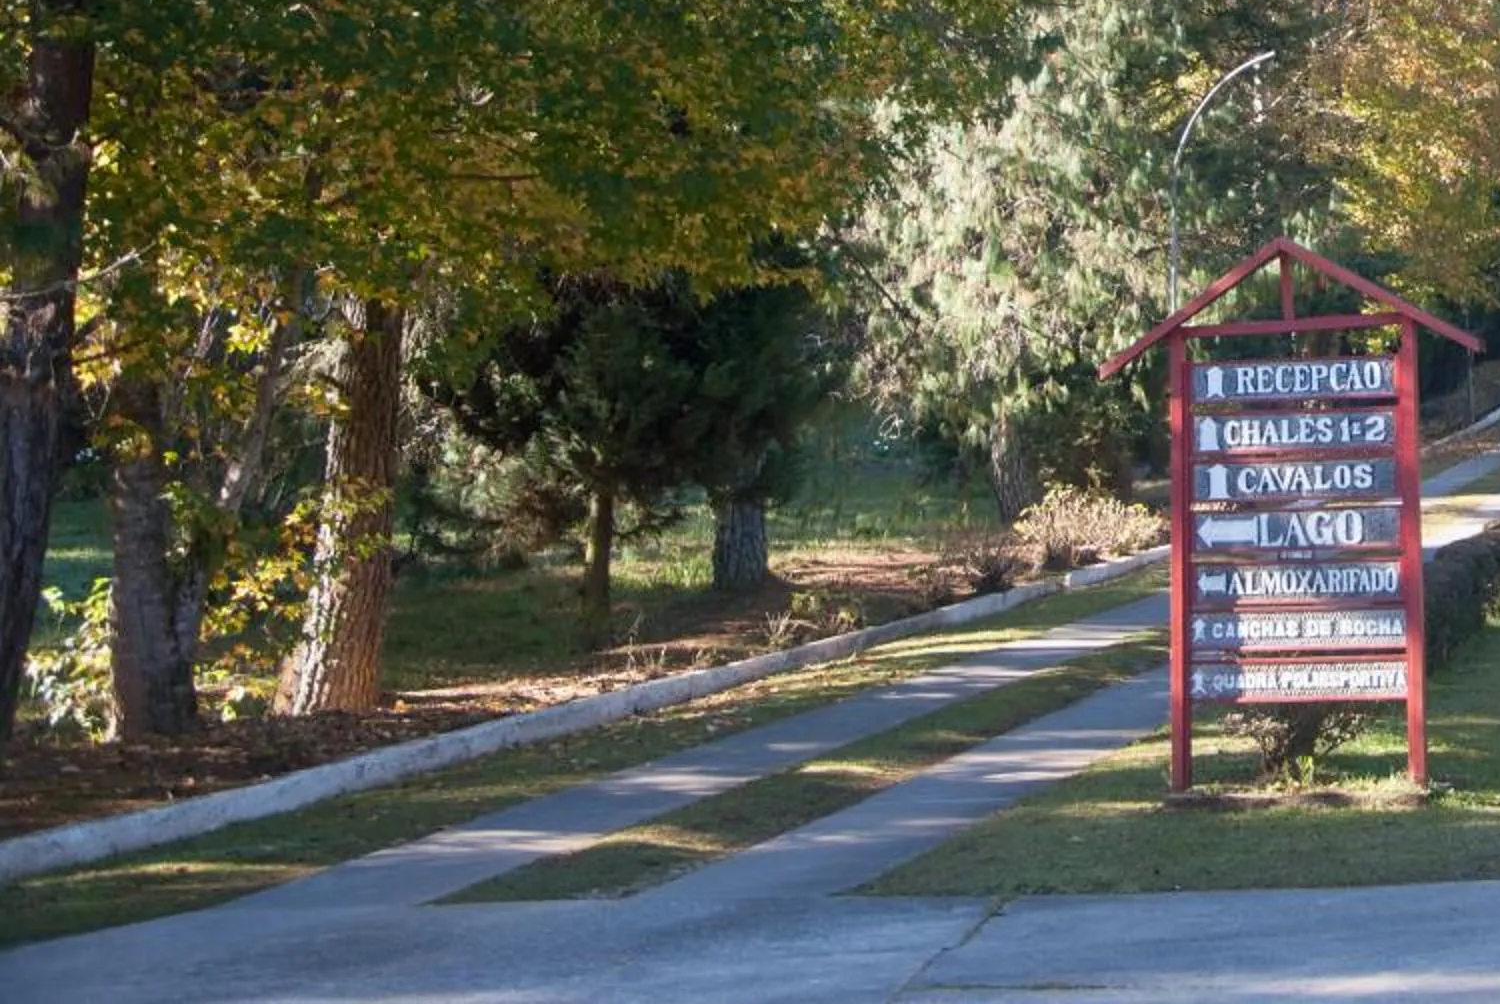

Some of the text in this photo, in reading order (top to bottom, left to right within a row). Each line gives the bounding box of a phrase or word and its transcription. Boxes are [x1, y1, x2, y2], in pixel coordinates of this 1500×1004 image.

[1237, 463, 1374, 493] CAVALOS
[1259, 509, 1364, 546] LAGO
[1228, 567, 1399, 596] ALMOXARIFADO
[1211, 619, 1300, 639] CANCHAS
[1304, 619, 1332, 638] DE
